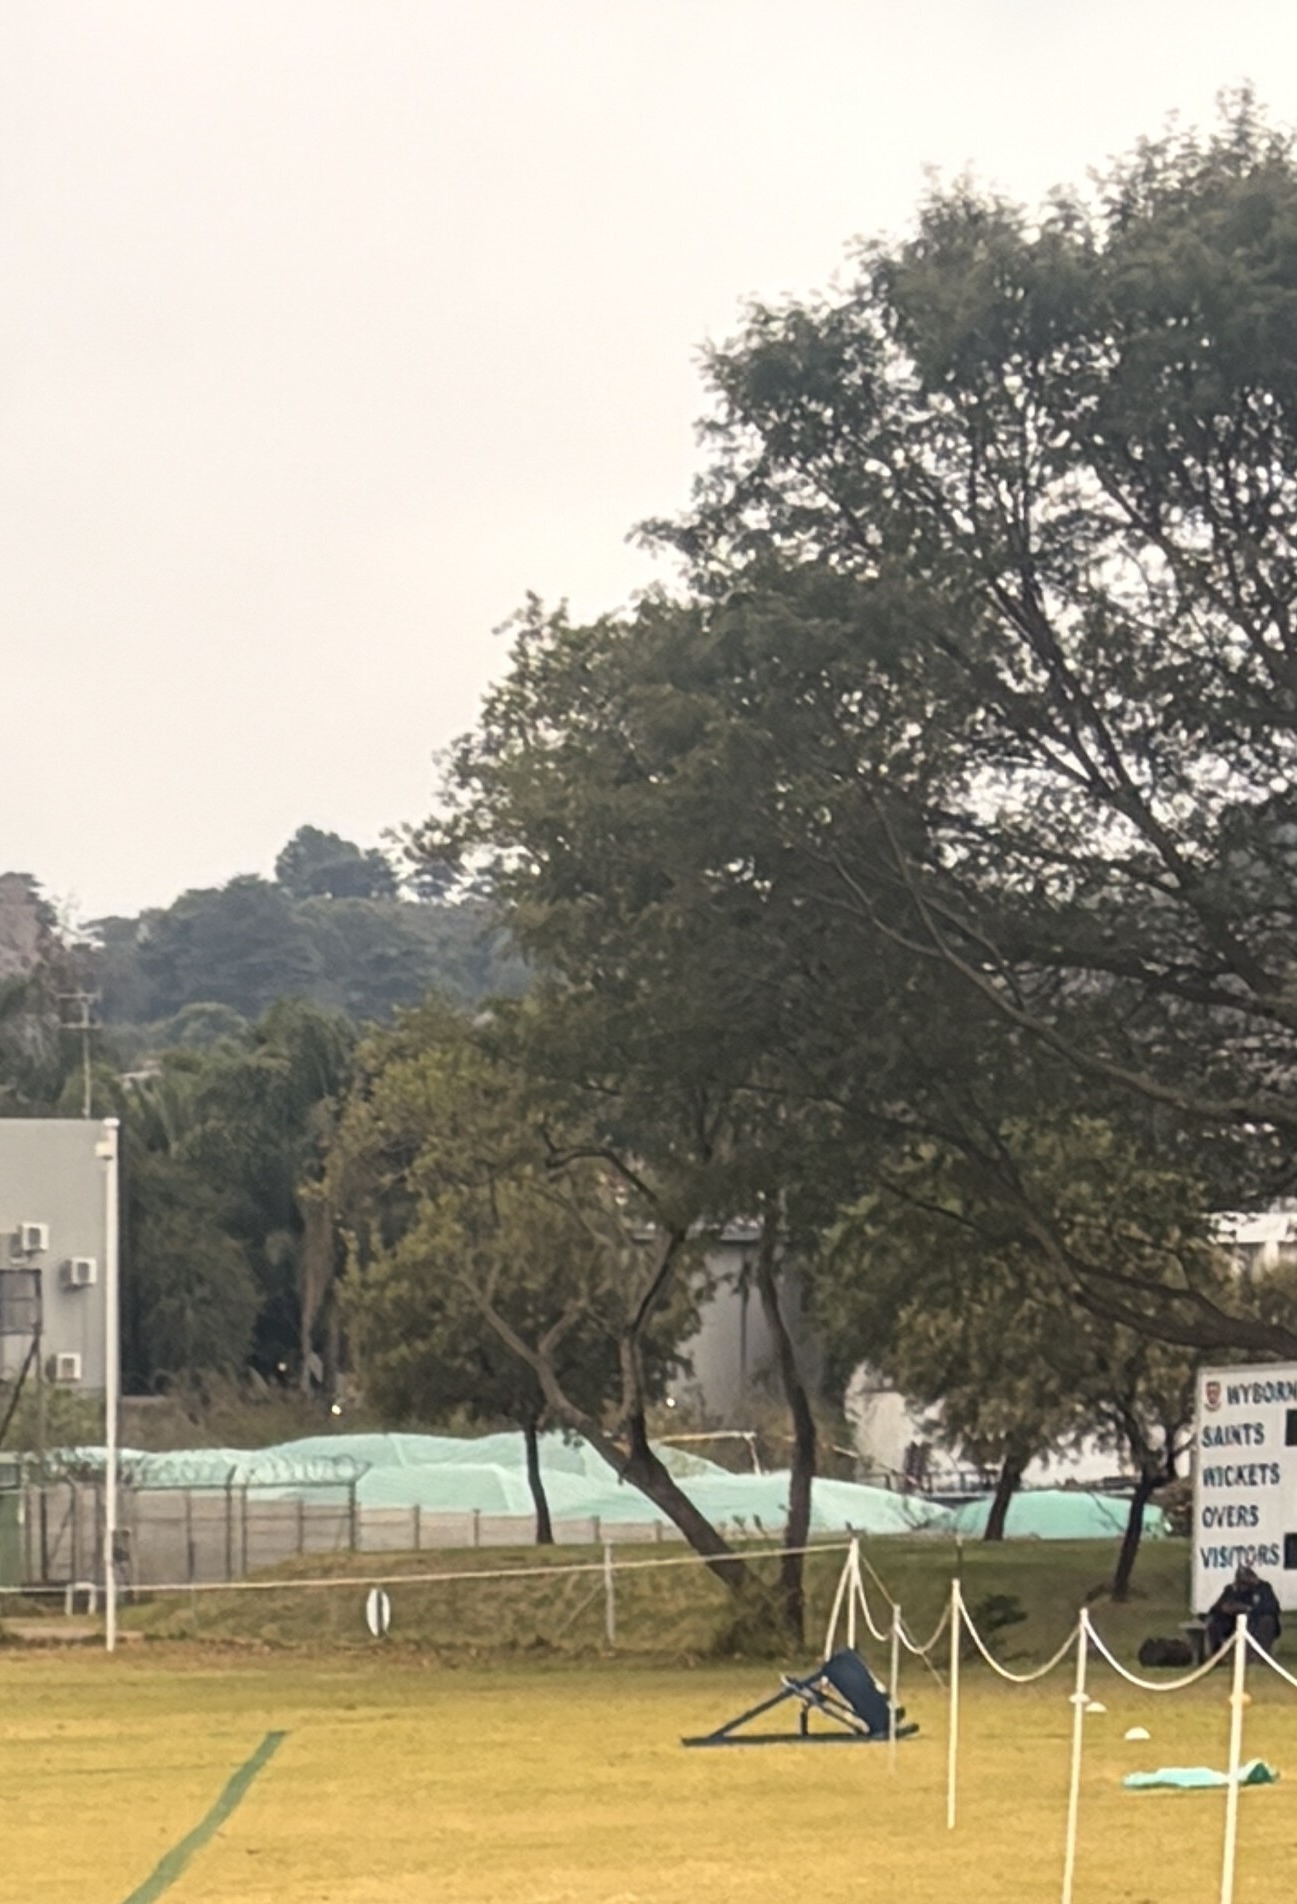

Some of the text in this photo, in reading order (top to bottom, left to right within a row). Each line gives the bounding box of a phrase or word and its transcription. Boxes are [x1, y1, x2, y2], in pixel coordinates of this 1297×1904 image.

[1202, 1422, 1265, 1448] SAINTS
[1203, 1463, 1280, 1487] WICKETS
[1202, 1505, 1259, 1529] OVERS
[1200, 1543, 1280, 1569] VISITORS
